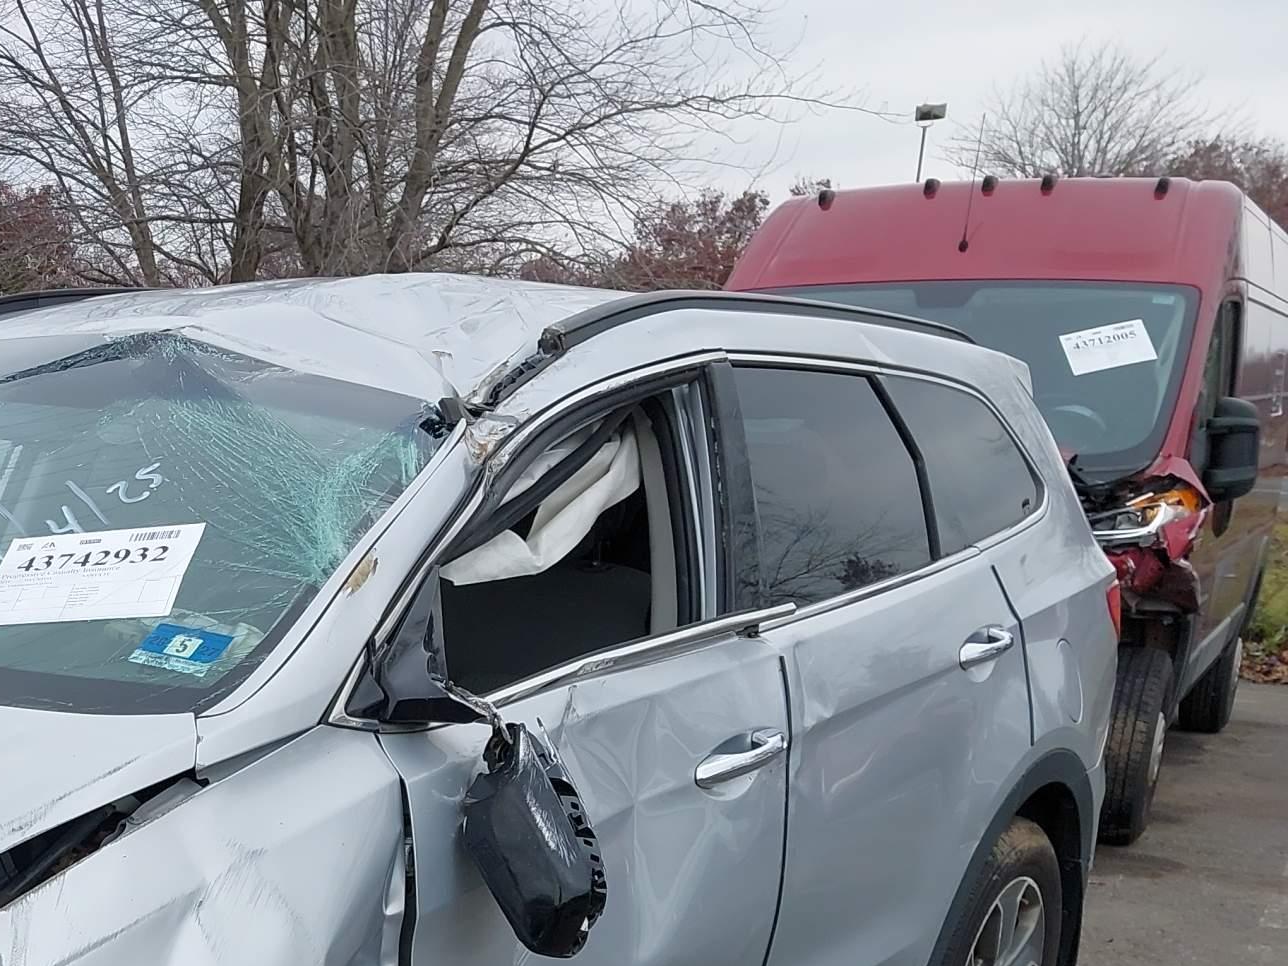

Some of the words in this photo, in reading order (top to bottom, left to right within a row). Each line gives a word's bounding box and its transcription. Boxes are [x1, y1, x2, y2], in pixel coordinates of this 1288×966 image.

[1073, 330, 1137, 350] 43712005
[17, 546, 170, 572] 43742932
[175, 638, 192, 653] 5
